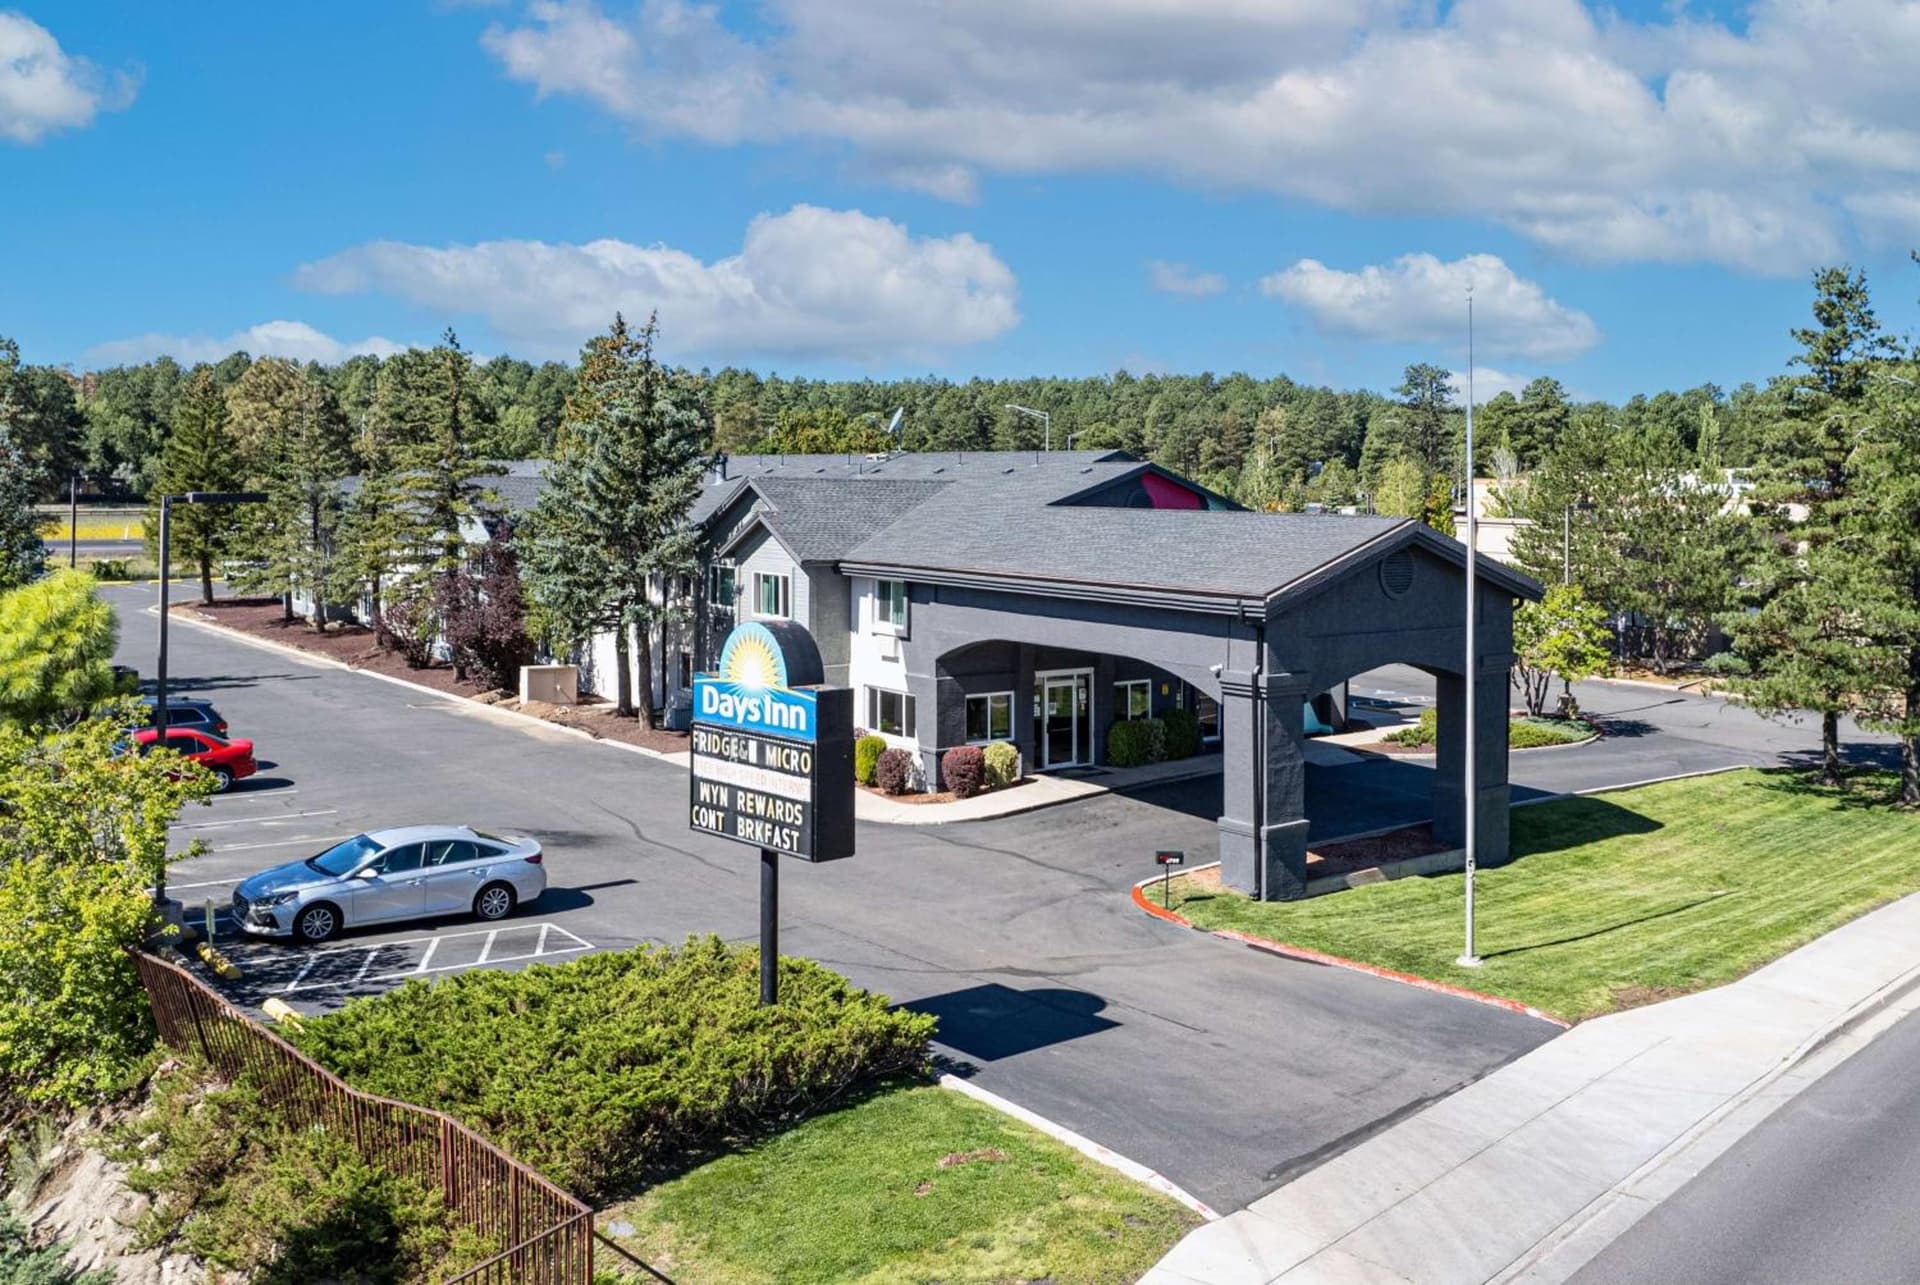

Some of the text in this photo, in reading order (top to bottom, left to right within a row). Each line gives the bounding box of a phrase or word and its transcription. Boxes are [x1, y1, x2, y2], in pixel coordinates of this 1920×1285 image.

[702, 684, 761, 724] Days
[766, 743, 812, 774] MICRO
[700, 781, 803, 826] WYN REWARDS
[692, 805, 800, 852] CONT BRKFAST
